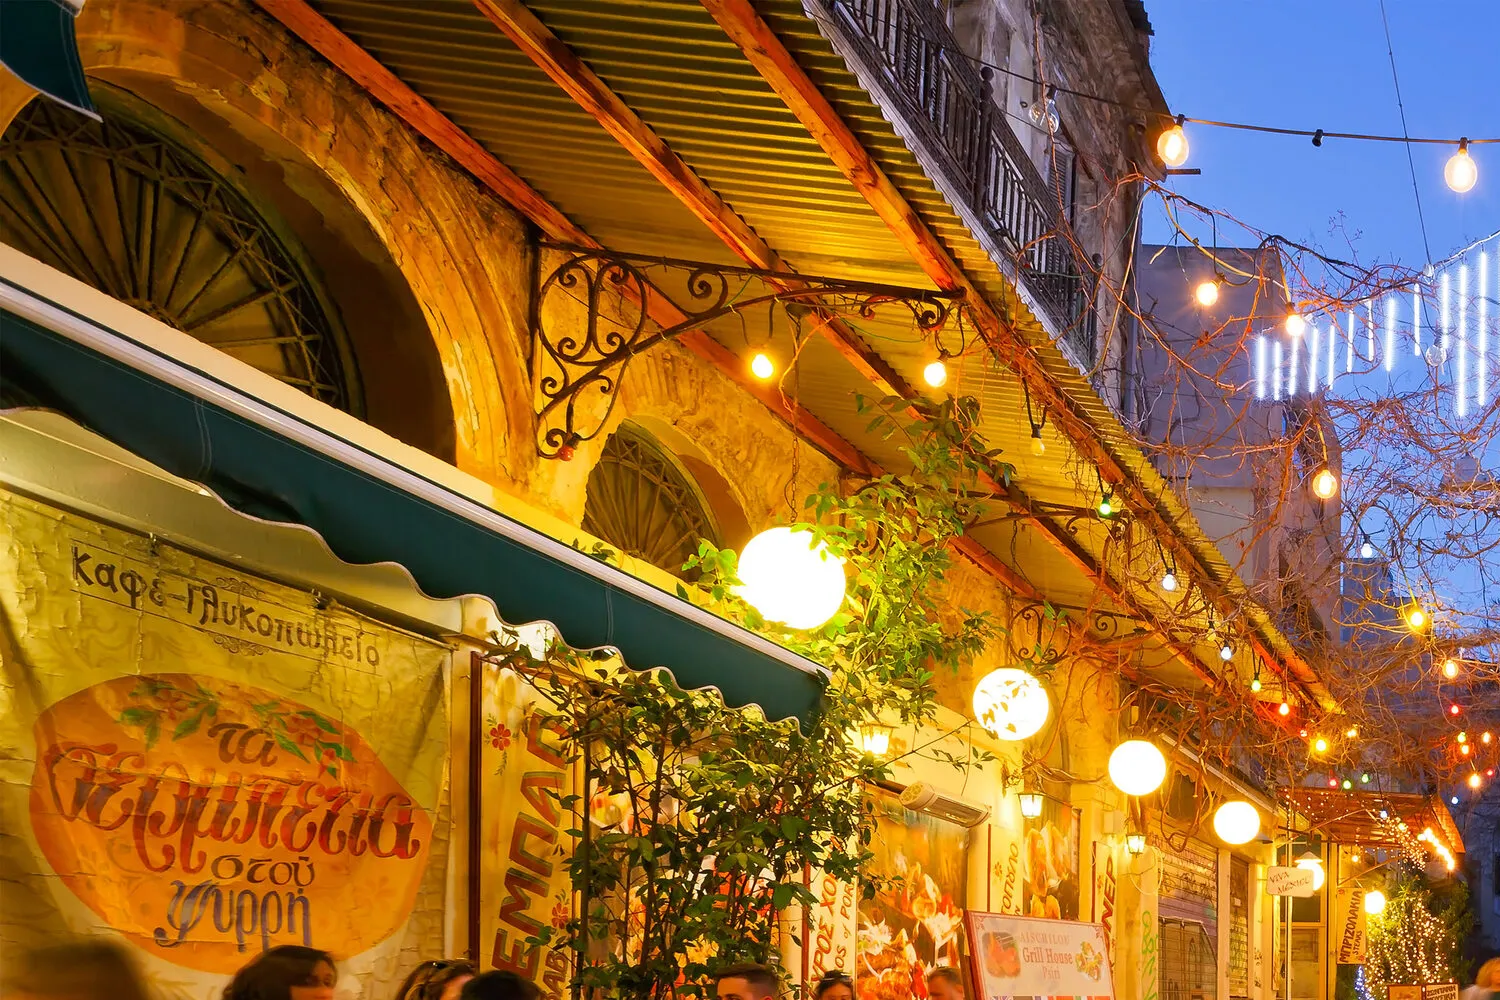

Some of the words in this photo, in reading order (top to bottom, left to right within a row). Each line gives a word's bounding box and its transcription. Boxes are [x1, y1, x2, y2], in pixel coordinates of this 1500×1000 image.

[491, 707, 570, 981] ΕΜΠΑΠ
[1101, 856, 1116, 936] ΝΕΡ
[834, 944, 847, 969] OS
[1023, 947, 1044, 963] Grill
[1045, 948, 1073, 964] House
